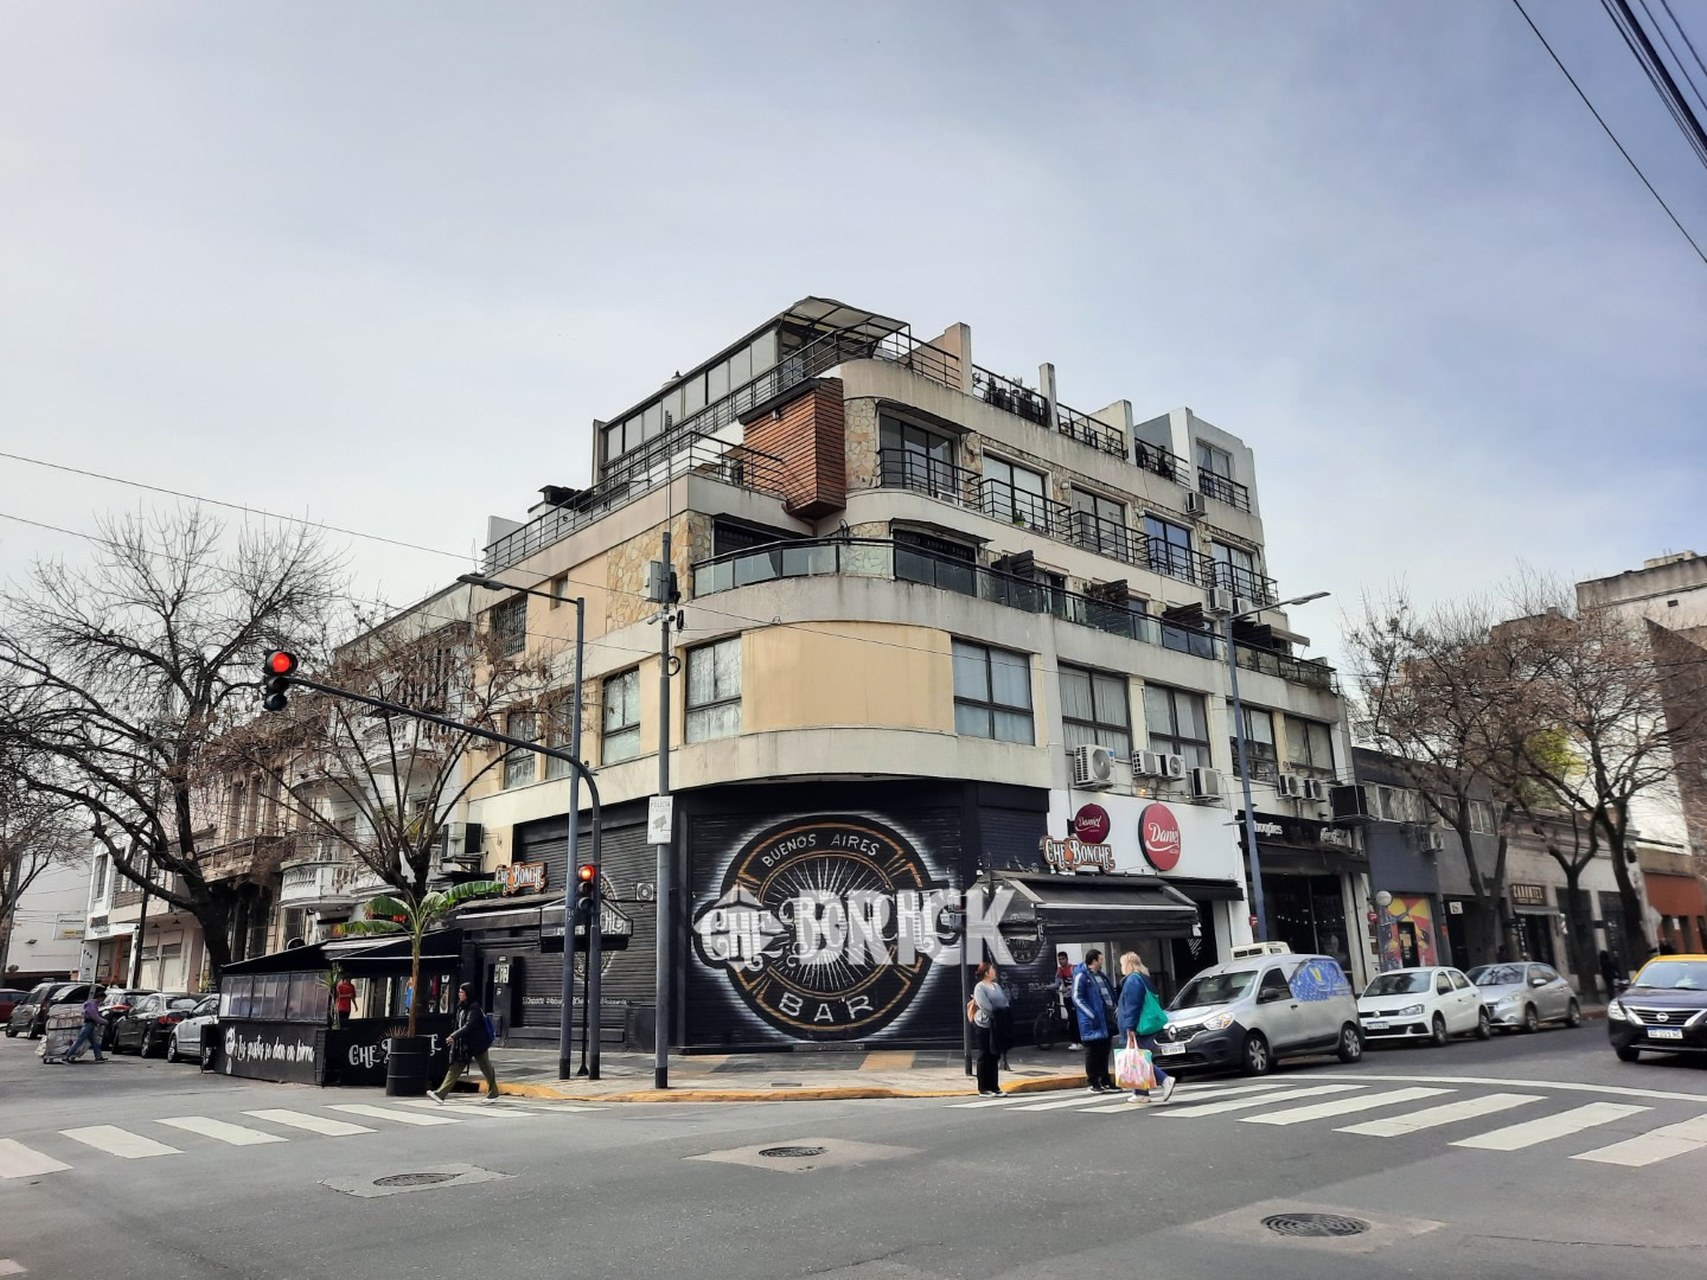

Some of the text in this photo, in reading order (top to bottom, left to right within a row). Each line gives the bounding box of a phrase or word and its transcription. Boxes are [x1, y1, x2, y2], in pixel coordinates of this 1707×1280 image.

[761, 833, 880, 868] BUENOS AIRES
[1045, 838, 1115, 871] CHE BONCHE
[700, 906, 782, 972] CHE
[778, 991, 875, 1023] BAR
[348, 1044, 381, 1069] CHE
